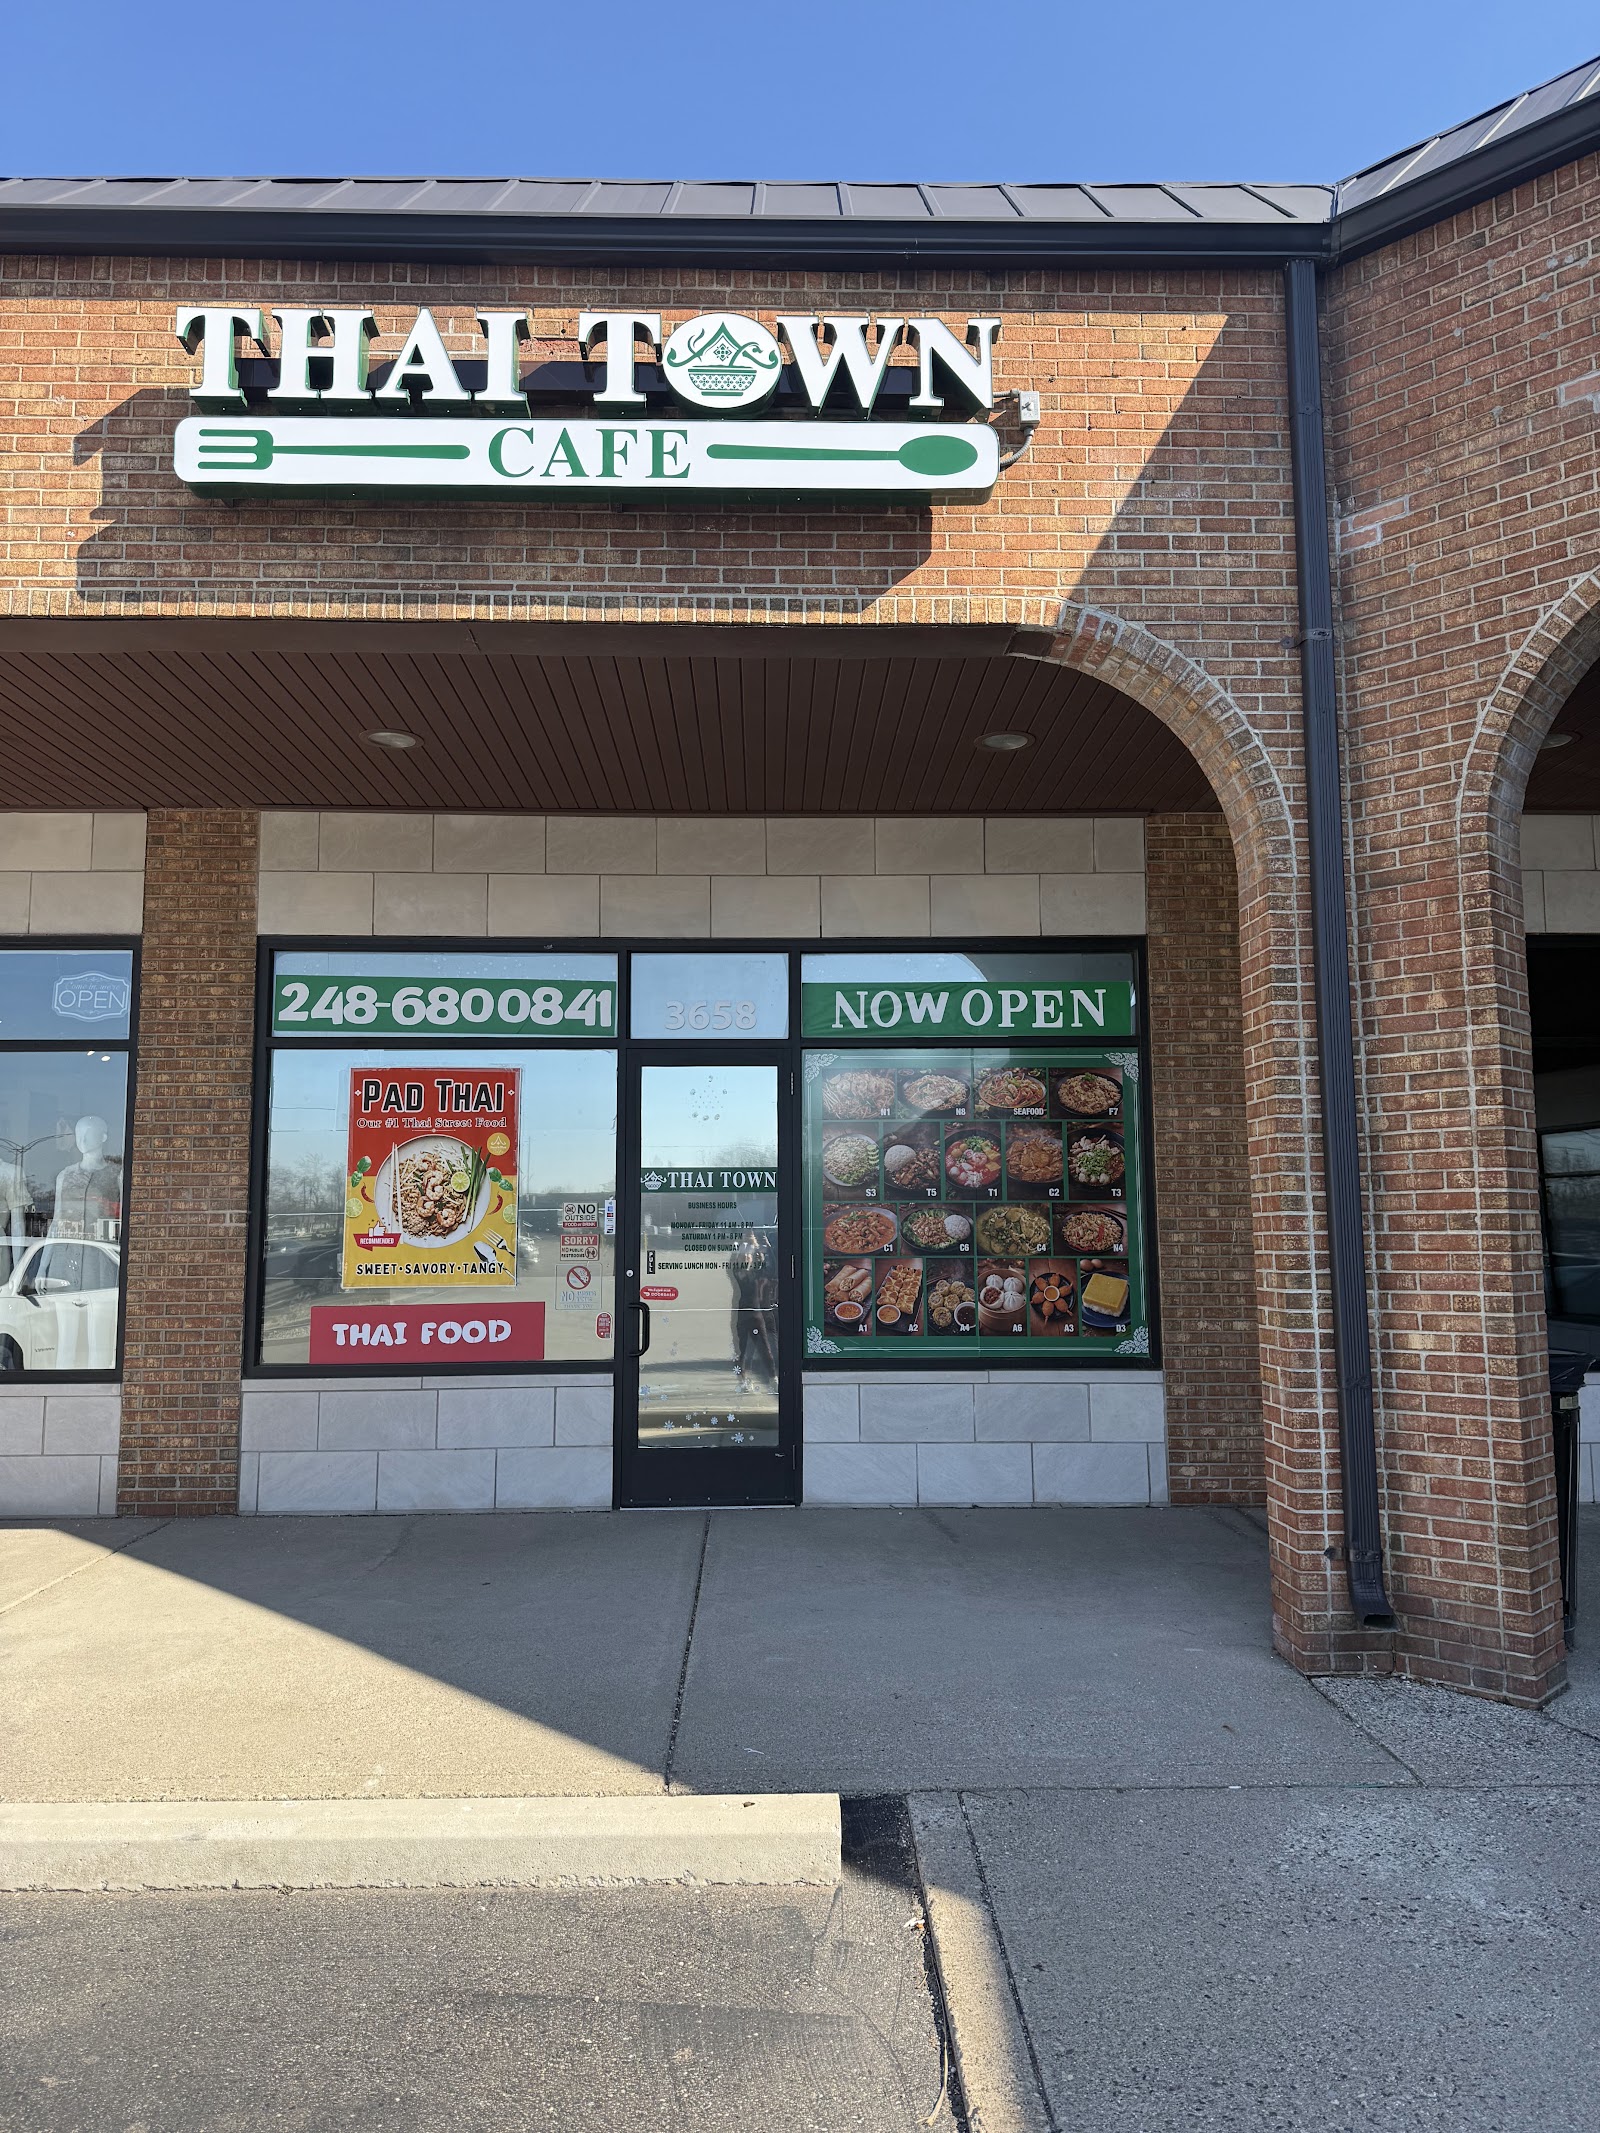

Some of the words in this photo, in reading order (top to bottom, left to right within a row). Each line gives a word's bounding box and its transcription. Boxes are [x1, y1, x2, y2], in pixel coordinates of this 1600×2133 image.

[176, 306, 531, 407] THAI
[488, 427, 691, 478] CAFE
[58, 990, 125, 1009] OPEN
[278, 982, 612, 1027] 248-6800841
[832, 990, 949, 1028] NOW
[961, 988, 1107, 1028] OPEN
[664, 999, 758, 1032] 3658
[362, 1079, 424, 1113] PAD
[434, 1079, 505, 1113] THAI
[880, 1108, 891, 1116] N1
[955, 1107, 966, 1116] N8
[1013, 1107, 1044, 1116] SEAFOOD
[1108, 1107, 1119, 1116] F7
[357, 1118, 383, 1128] Our
[384, 1118, 399, 1128] #1
[402, 1117, 432, 1128] Thai
[435, 1117, 472, 1128] Street
[475, 1117, 507, 1128] Food
[667, 1171, 714, 1188] THAI
[720, 1171, 777, 1188] TOWN
[865, 1188, 877, 1197] S3
[926, 1188, 937, 1197] T5
[988, 1188, 998, 1197] T1
[1048, 1188, 1060, 1197] C2
[1111, 1188, 1122, 1197] T3
[577, 1204, 596, 1214] NO
[359, 1237, 395, 1245] RECOMMENDED
[564, 1237, 595, 1245] SORRY
[684, 1244, 707, 1252] CLOSED
[707, 1244, 716, 1252] ON
[716, 1244, 740, 1252] SUNDAY
[883, 1244, 893, 1252] C1
[959, 1244, 970, 1252] C6
[1036, 1244, 1047, 1252] C4
[1113, 1244, 1124, 1252] N4
[658, 1262, 684, 1270] SERVING
[684, 1262, 704, 1270] LUNCH
[705, 1262, 718, 1270] MON
[722, 1262, 732, 1270] FRI
[732, 1262, 739, 1270] 11
[739, 1262, 748, 1270] AM
[561, 1291, 575, 1302] NO
[332, 1322, 408, 1346] THAI
[420, 1319, 512, 1345] FOOD
[858, 1324, 868, 1332] A1
[908, 1324, 919, 1332] A2
[959, 1324, 970, 1332] A4
[1012, 1324, 1023, 1332] A6
[1064, 1324, 1074, 1332] A3
[1115, 1324, 1126, 1332] D3
